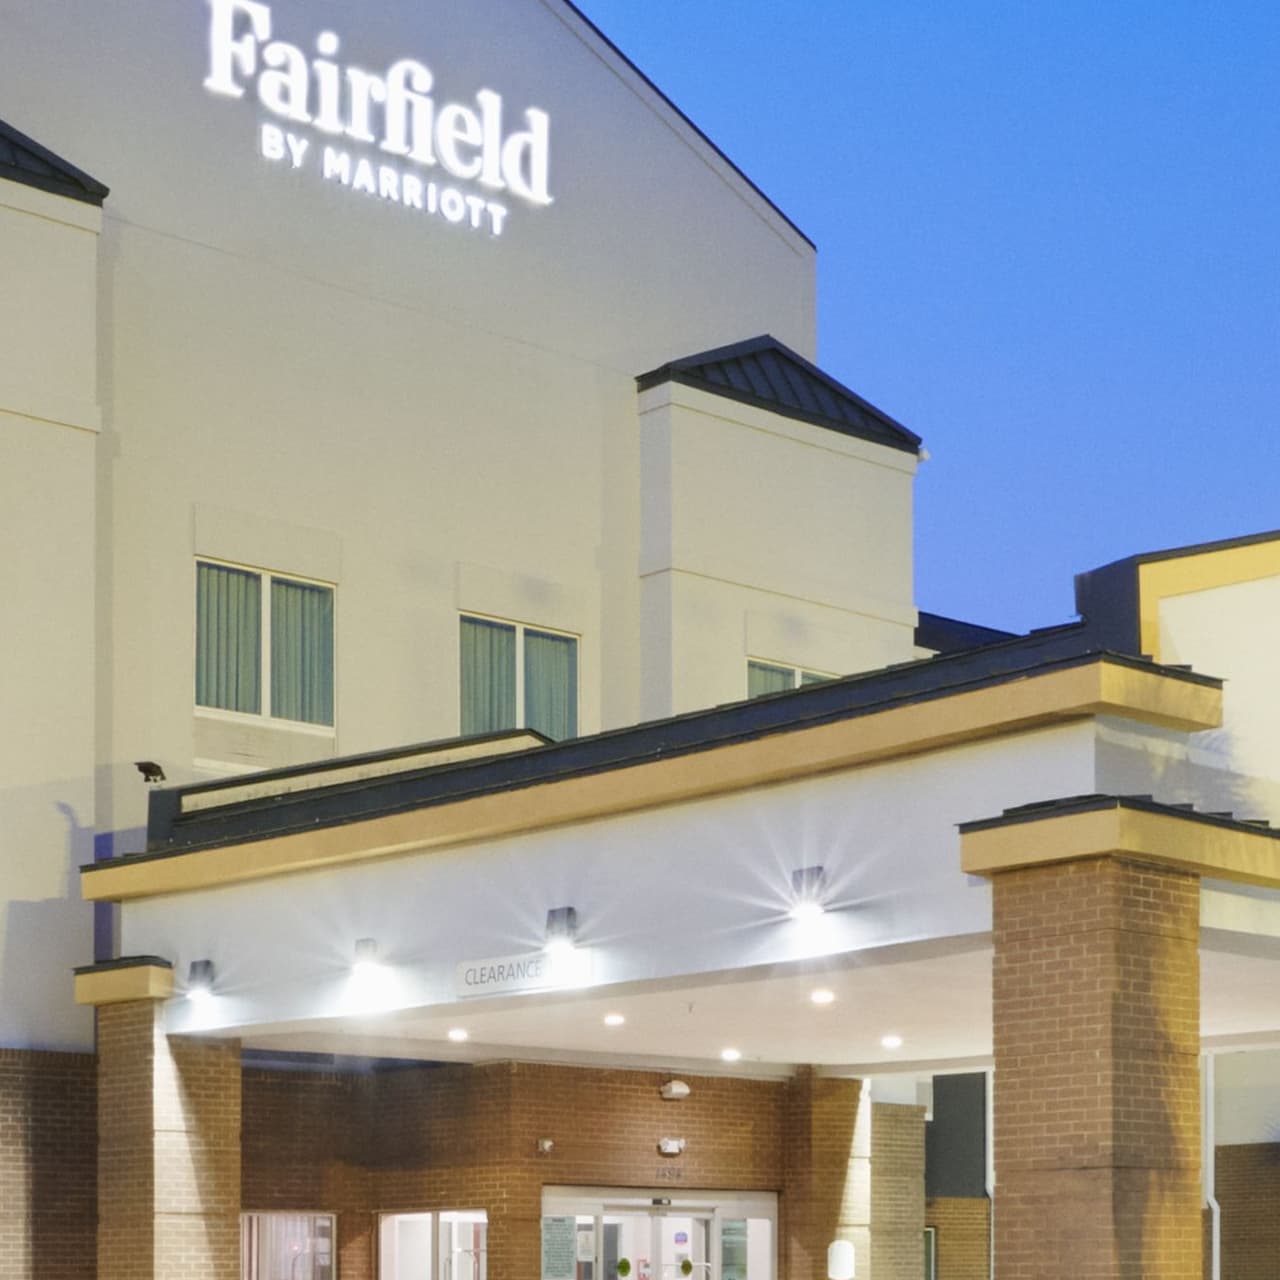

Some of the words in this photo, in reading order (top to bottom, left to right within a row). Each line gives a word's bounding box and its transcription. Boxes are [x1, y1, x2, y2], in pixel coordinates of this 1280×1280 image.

[261, 124, 309, 168] BY
[323, 147, 507, 235] MARRIOTT
[464, 960, 542, 986] CLEARANCE
